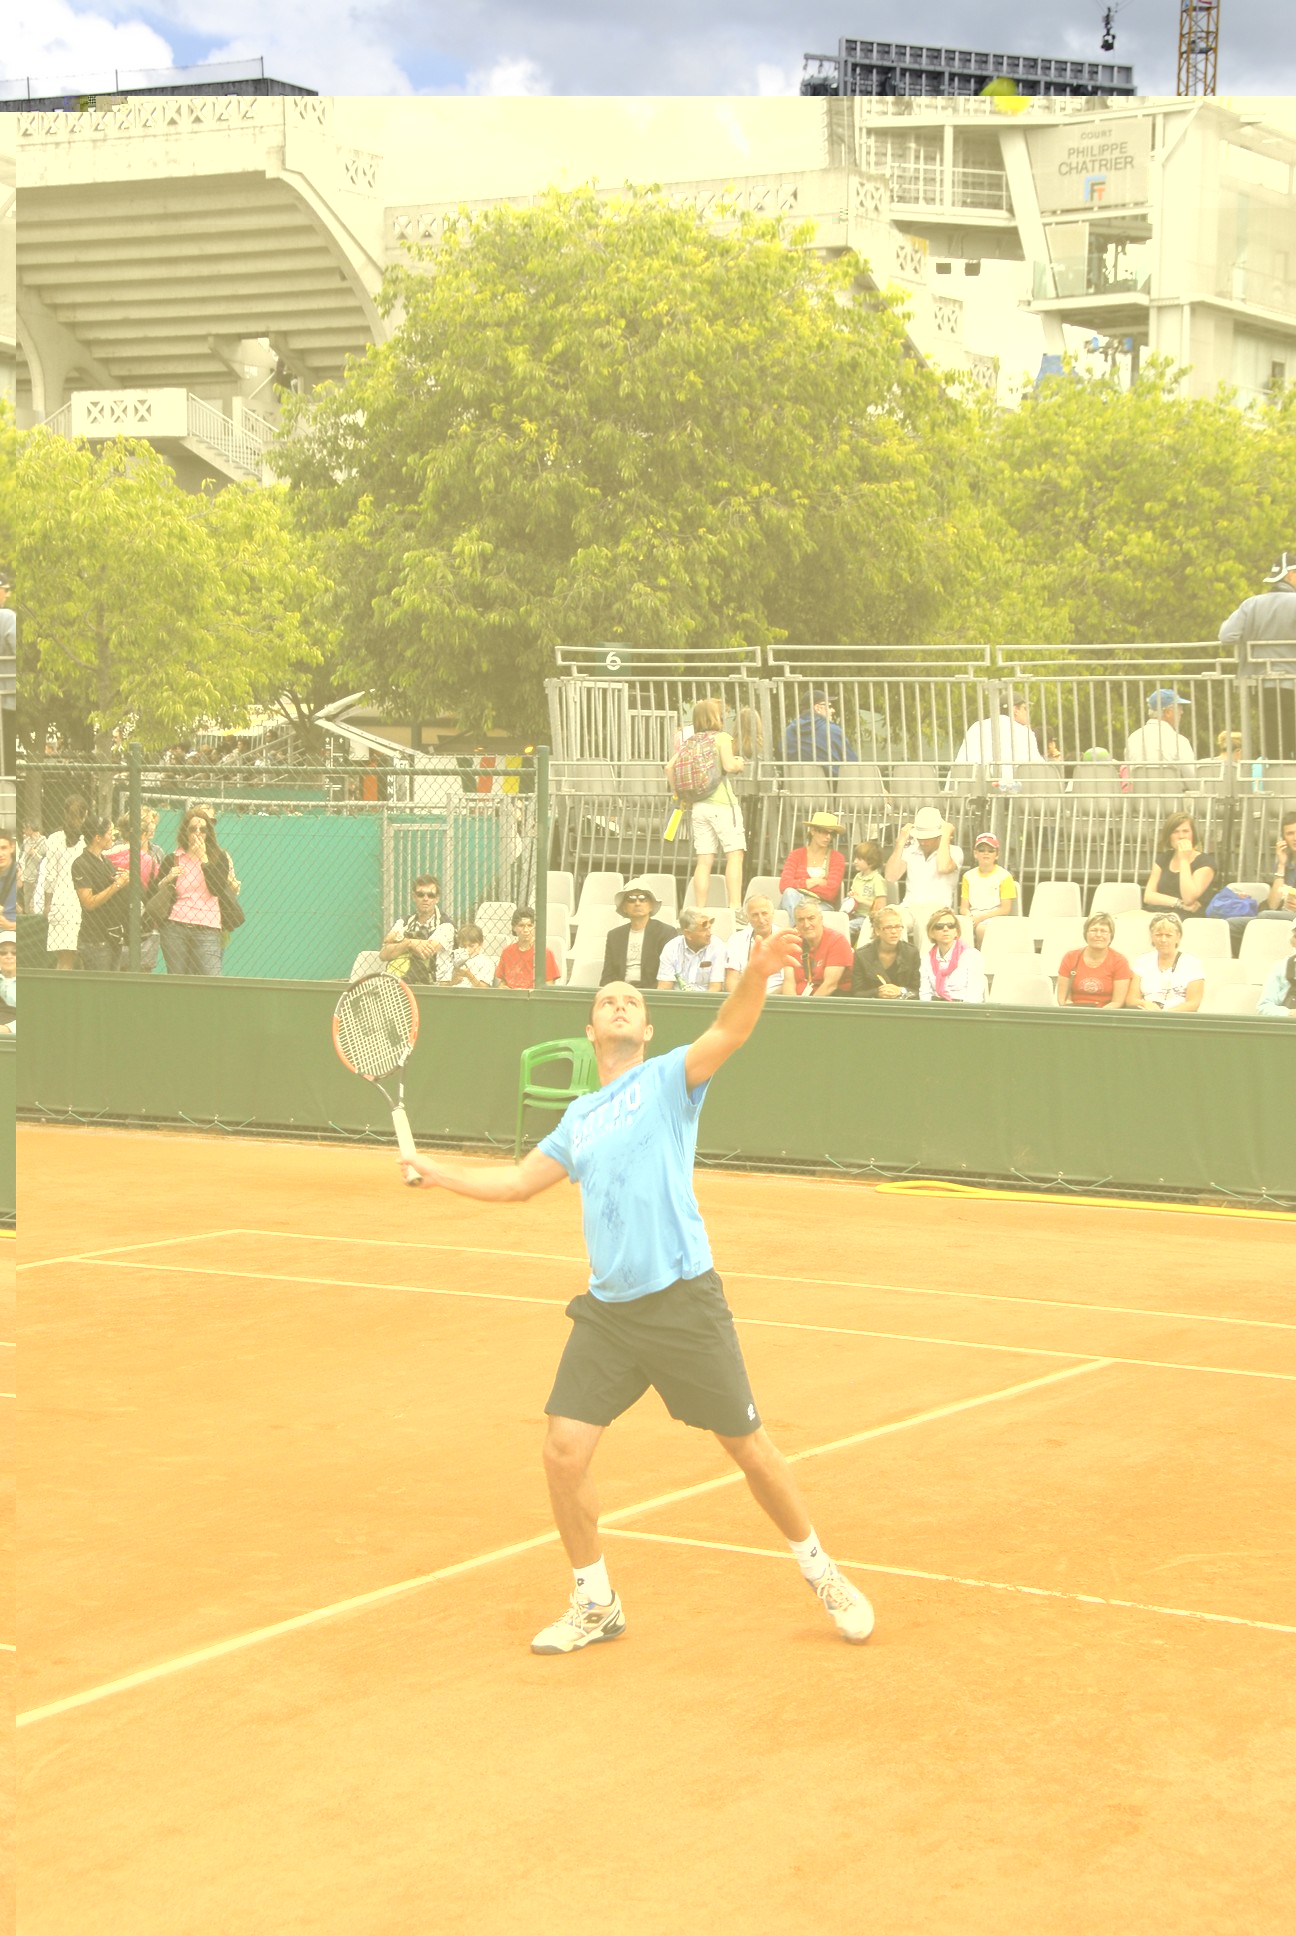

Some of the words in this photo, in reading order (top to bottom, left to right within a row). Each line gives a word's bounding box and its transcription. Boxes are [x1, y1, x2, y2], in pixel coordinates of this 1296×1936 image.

[1081, 129, 1112, 139] COURT
[1068, 141, 1128, 159] PHILIPPE
[1058, 155, 1134, 176] CHATRIER
[605, 651, 621, 670] 6
